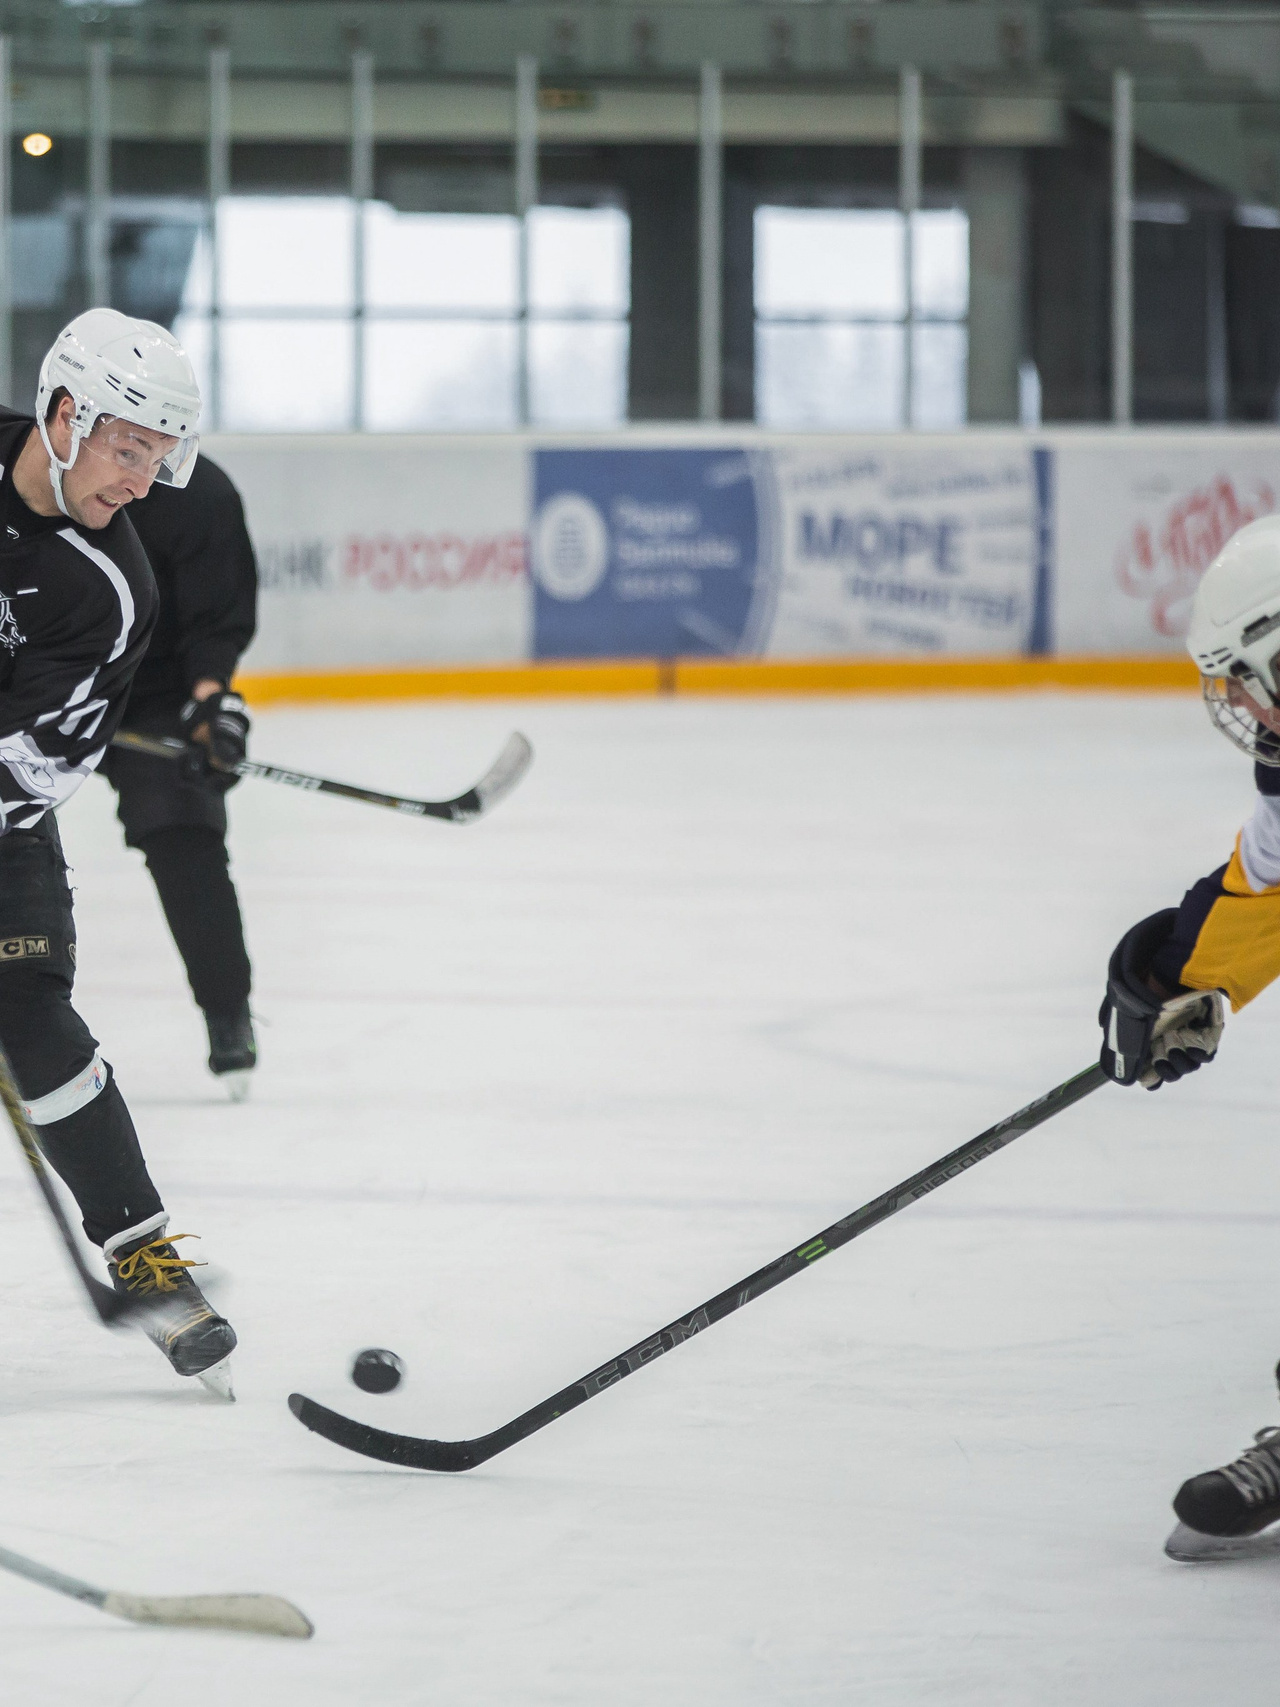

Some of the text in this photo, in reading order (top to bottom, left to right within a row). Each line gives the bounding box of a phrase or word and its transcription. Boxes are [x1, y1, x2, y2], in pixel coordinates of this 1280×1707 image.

[58, 353, 86, 372] BAUER
[799, 509, 960, 575] МОРЕ
[576, 1307, 710, 1399] CCM
